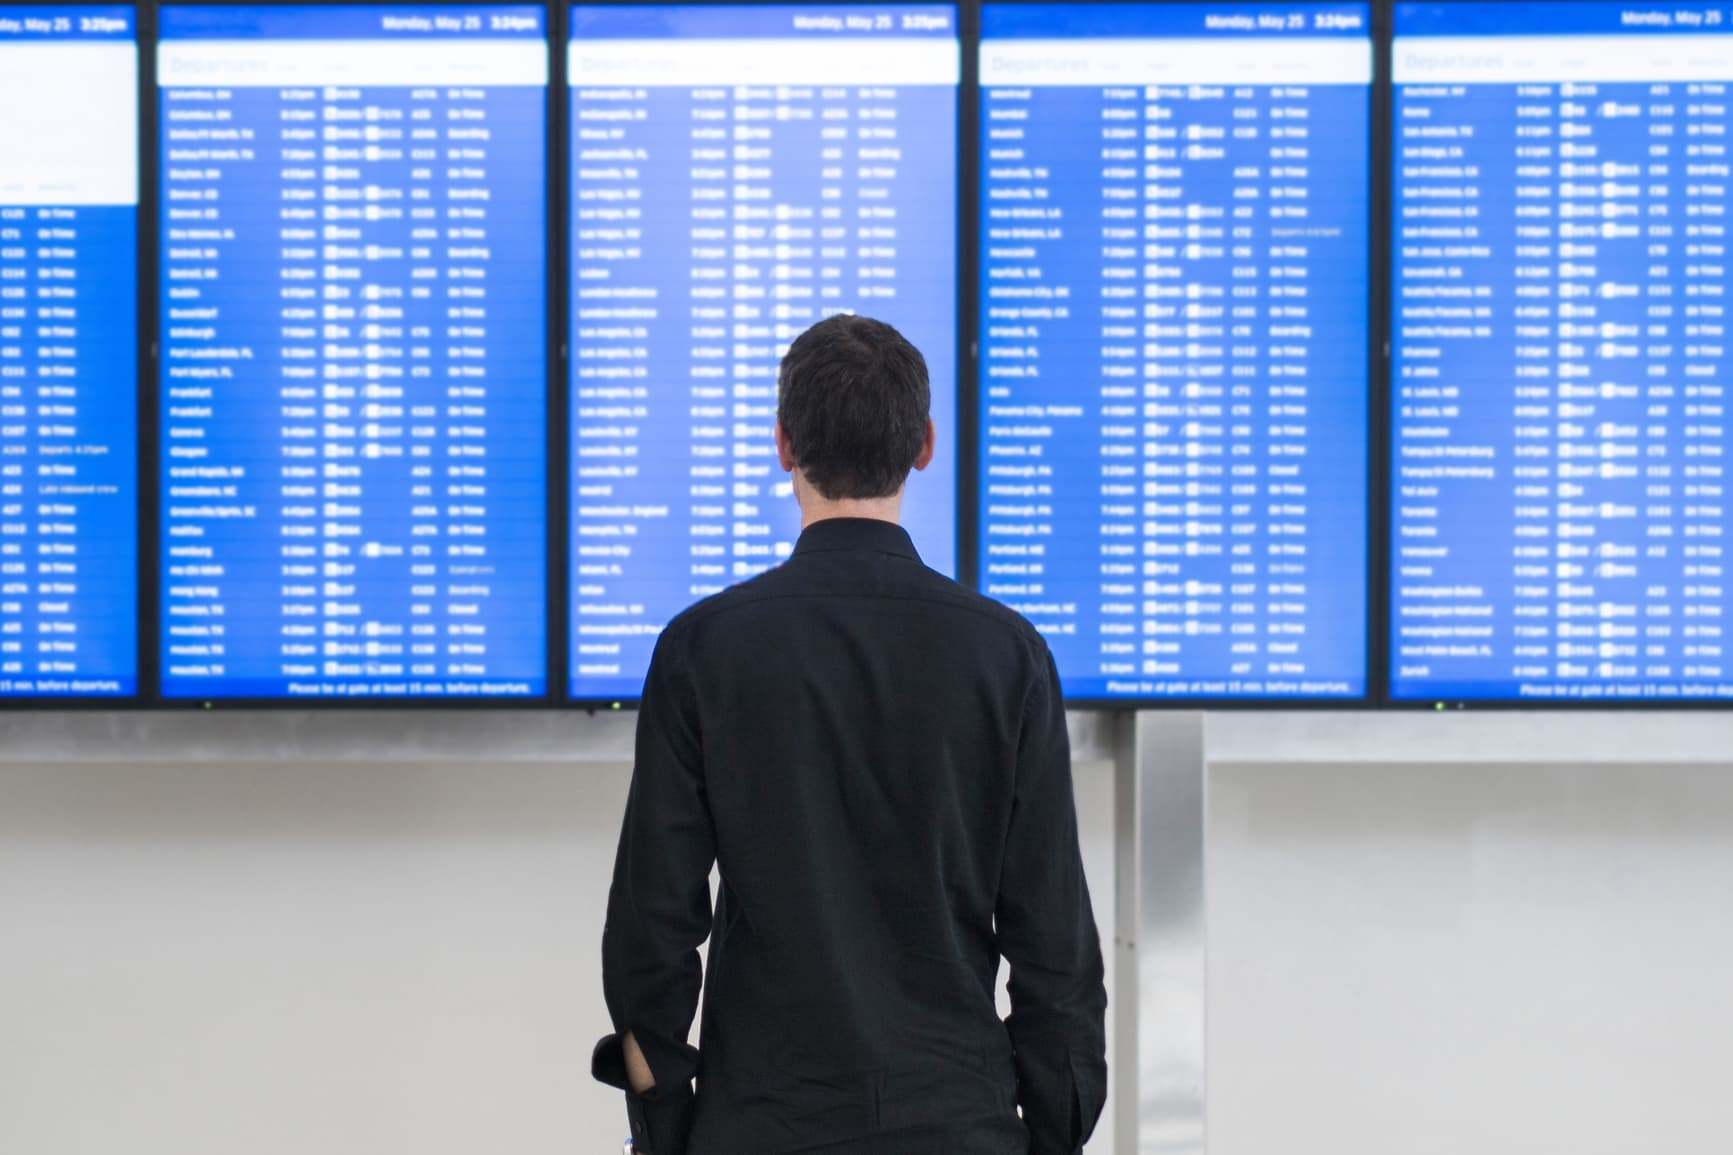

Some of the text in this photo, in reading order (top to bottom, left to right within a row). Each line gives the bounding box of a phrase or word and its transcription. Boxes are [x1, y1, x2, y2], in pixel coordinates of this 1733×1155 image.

[25, 18, 50, 33] May
[382, 16, 431, 30] Monday,
[435, 16, 462, 30] May
[792, 15, 842, 30] Monday,
[846, 15, 872, 30] May
[1205, 15, 1254, 30] Monday,
[1258, 15, 1285, 30] May
[1622, 12, 1672, 26] Monday,
[1676, 12, 1702, 26] May
[991, 55, 1091, 74] Departures
[1405, 52, 1505, 71] Departures
[38, 681, 69, 691] before
[289, 684, 319, 694] Please
[322, 684, 334, 694] be
[337, 684, 346, 694] at
[348, 684, 368, 696] gate
[372, 684, 381, 694] at
[384, 684, 406, 694] least
[447, 684, 477, 694] before
[1107, 682, 1138, 692] Please
[1141, 682, 1152, 692] be
[1155, 682, 1165, 692] at
[1167, 682, 1188, 694] gate
[1191, 682, 1200, 692] at
[1203, 682, 1226, 692] least
[1266, 682, 1297, 692] before
[1521, 685, 1552, 695] Please
[1555, 685, 1565, 695] be
[1569, 685, 1578, 695] at
[1582, 685, 1602, 696] gate
[1606, 685, 1614, 695] at
[1618, 685, 1640, 695] least
[1681, 685, 1713, 695] before
